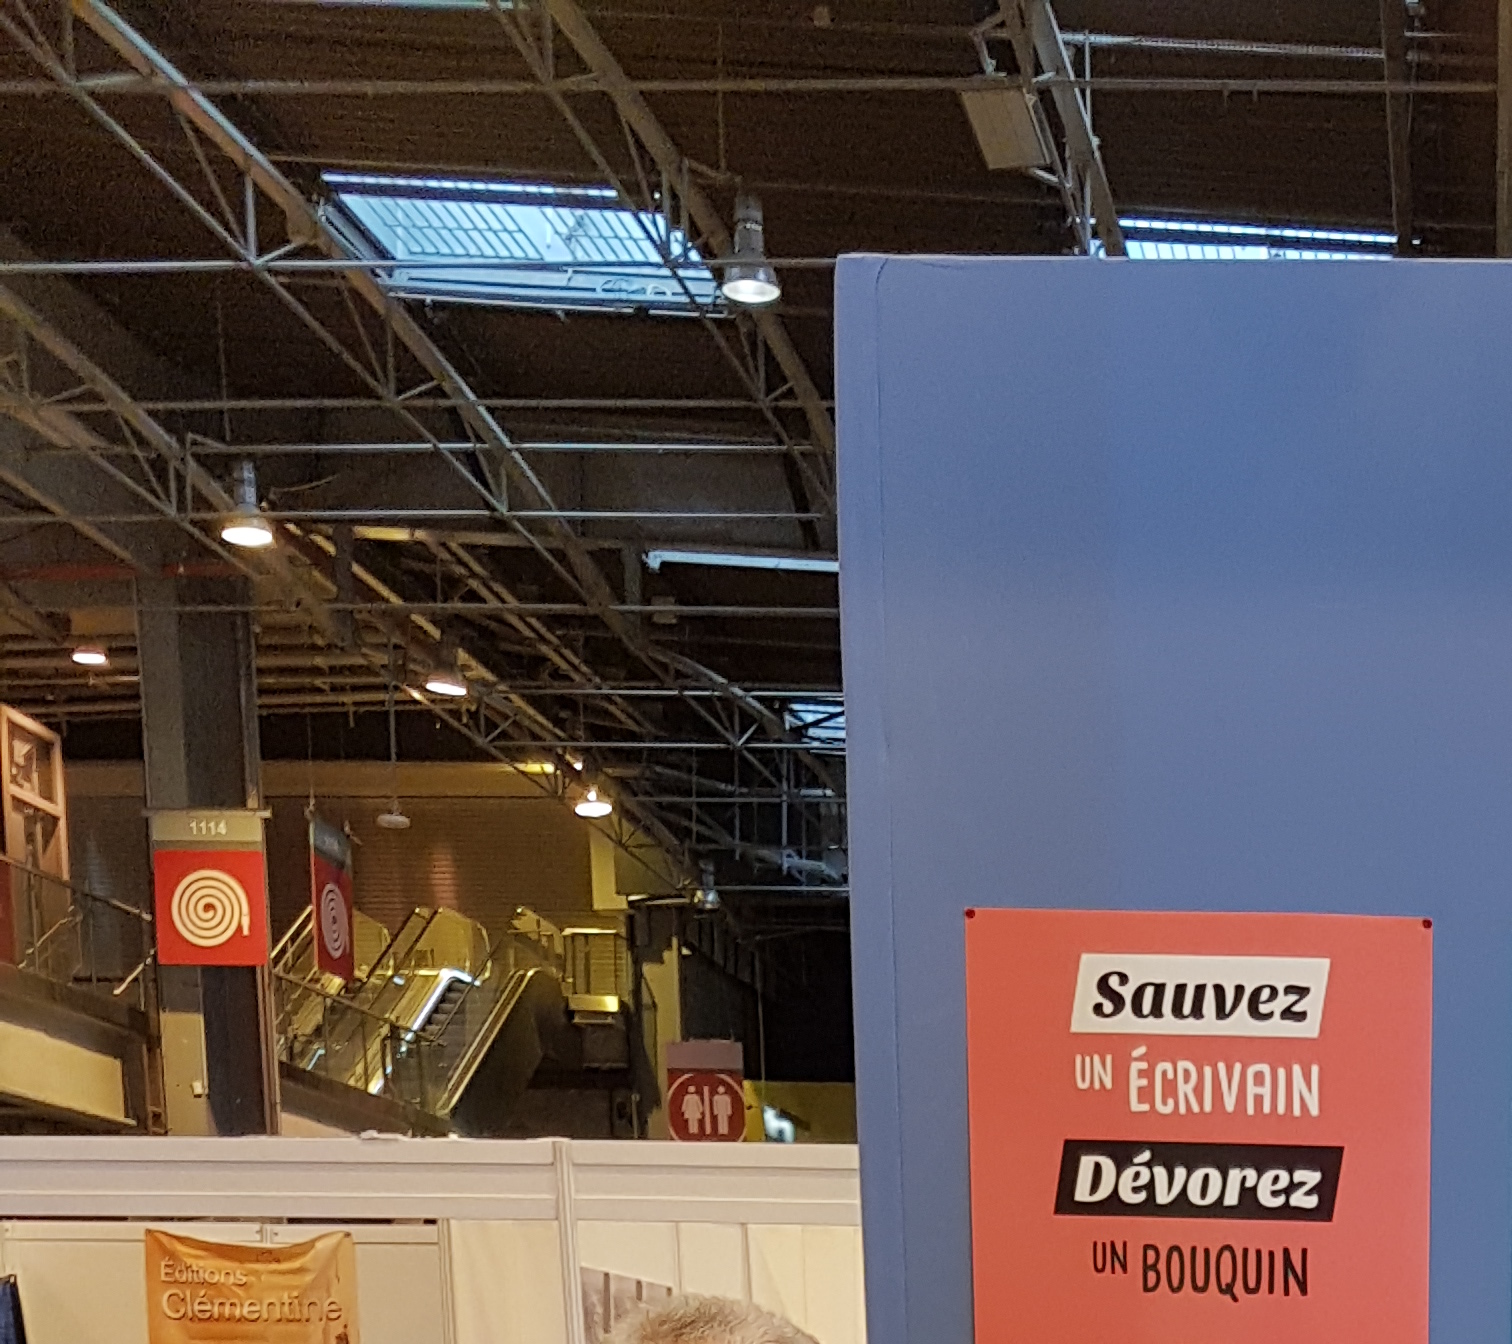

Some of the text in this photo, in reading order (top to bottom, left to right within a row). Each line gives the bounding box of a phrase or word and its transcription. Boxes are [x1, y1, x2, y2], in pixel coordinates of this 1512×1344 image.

[189, 819, 228, 836] 1114
[1091, 969, 1311, 1024] Sauvez
[1074, 1046, 1321, 1117] UN ÉCRIVAIN
[1073, 1149, 1324, 1211] Dévorez
[1091, 1239, 1309, 1302] UN BOUQUIN
[161, 1288, 342, 1323] Clémentine
